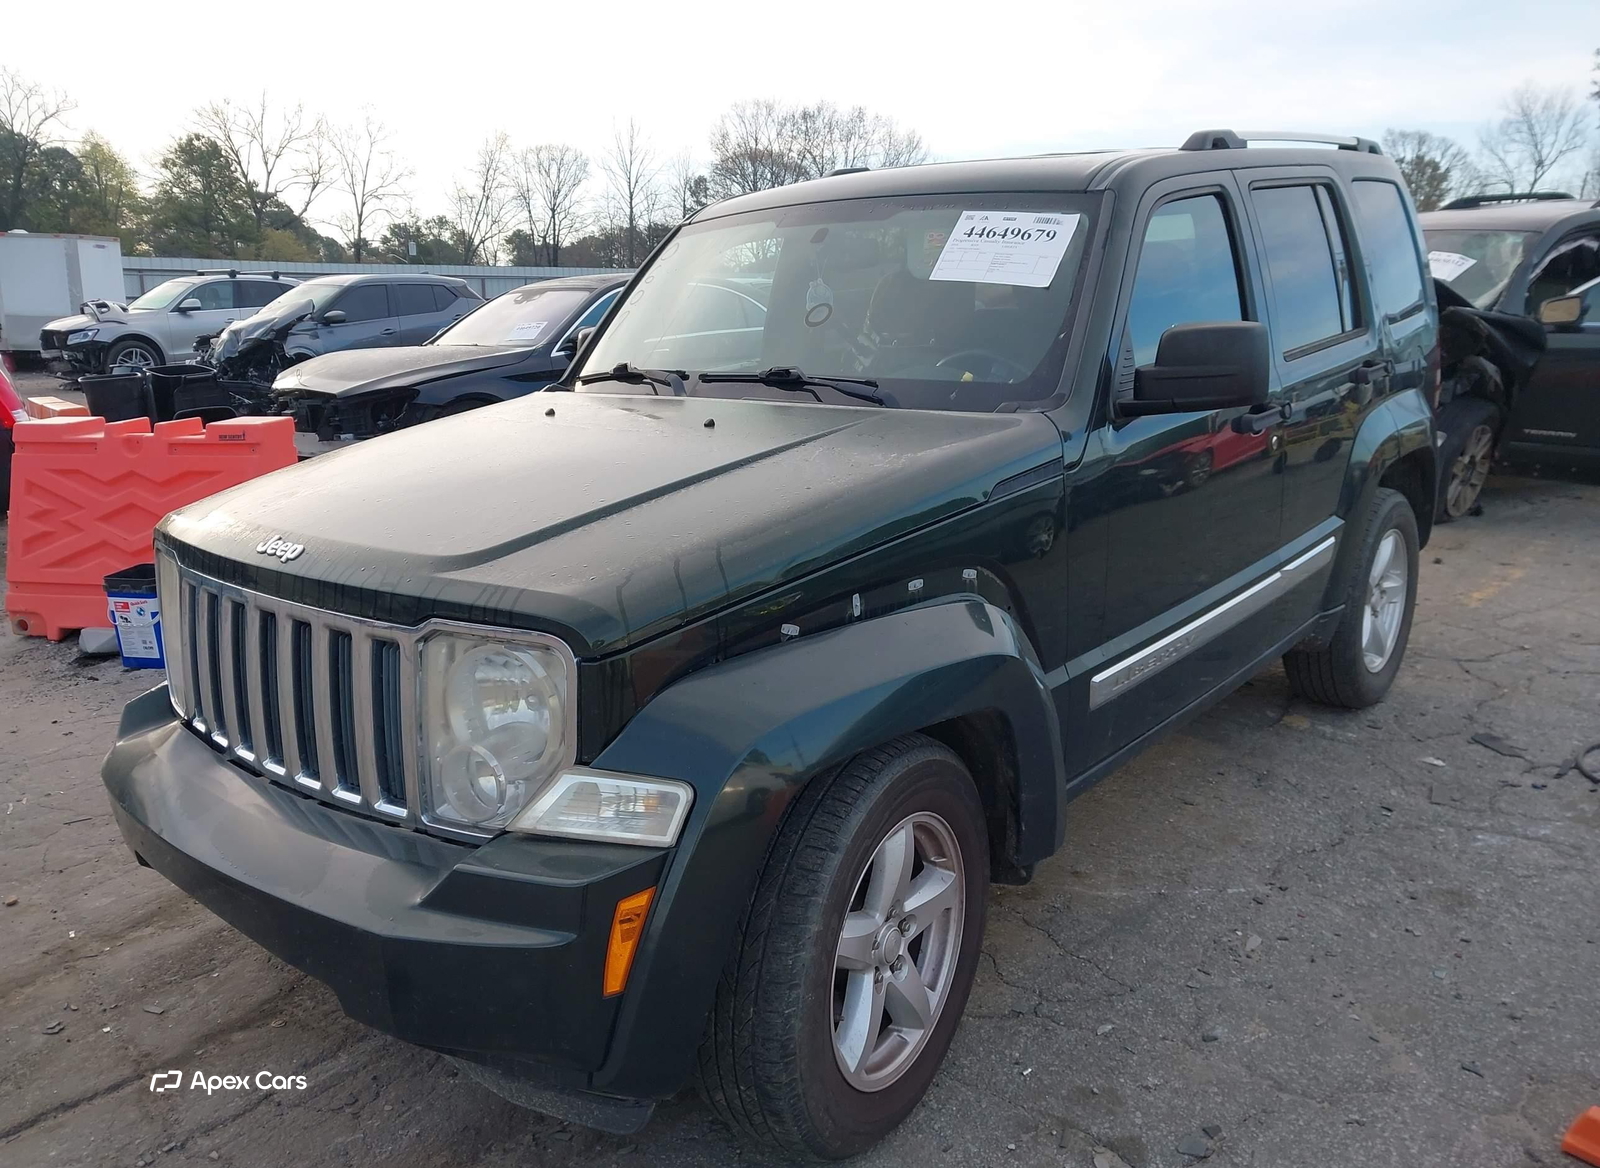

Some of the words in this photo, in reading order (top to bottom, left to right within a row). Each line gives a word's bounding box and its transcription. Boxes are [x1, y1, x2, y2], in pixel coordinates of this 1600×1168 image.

[963, 225, 1058, 243] 44649679
[256, 534, 305, 564] Jeep
[1112, 634, 1196, 691] LIBERTY
